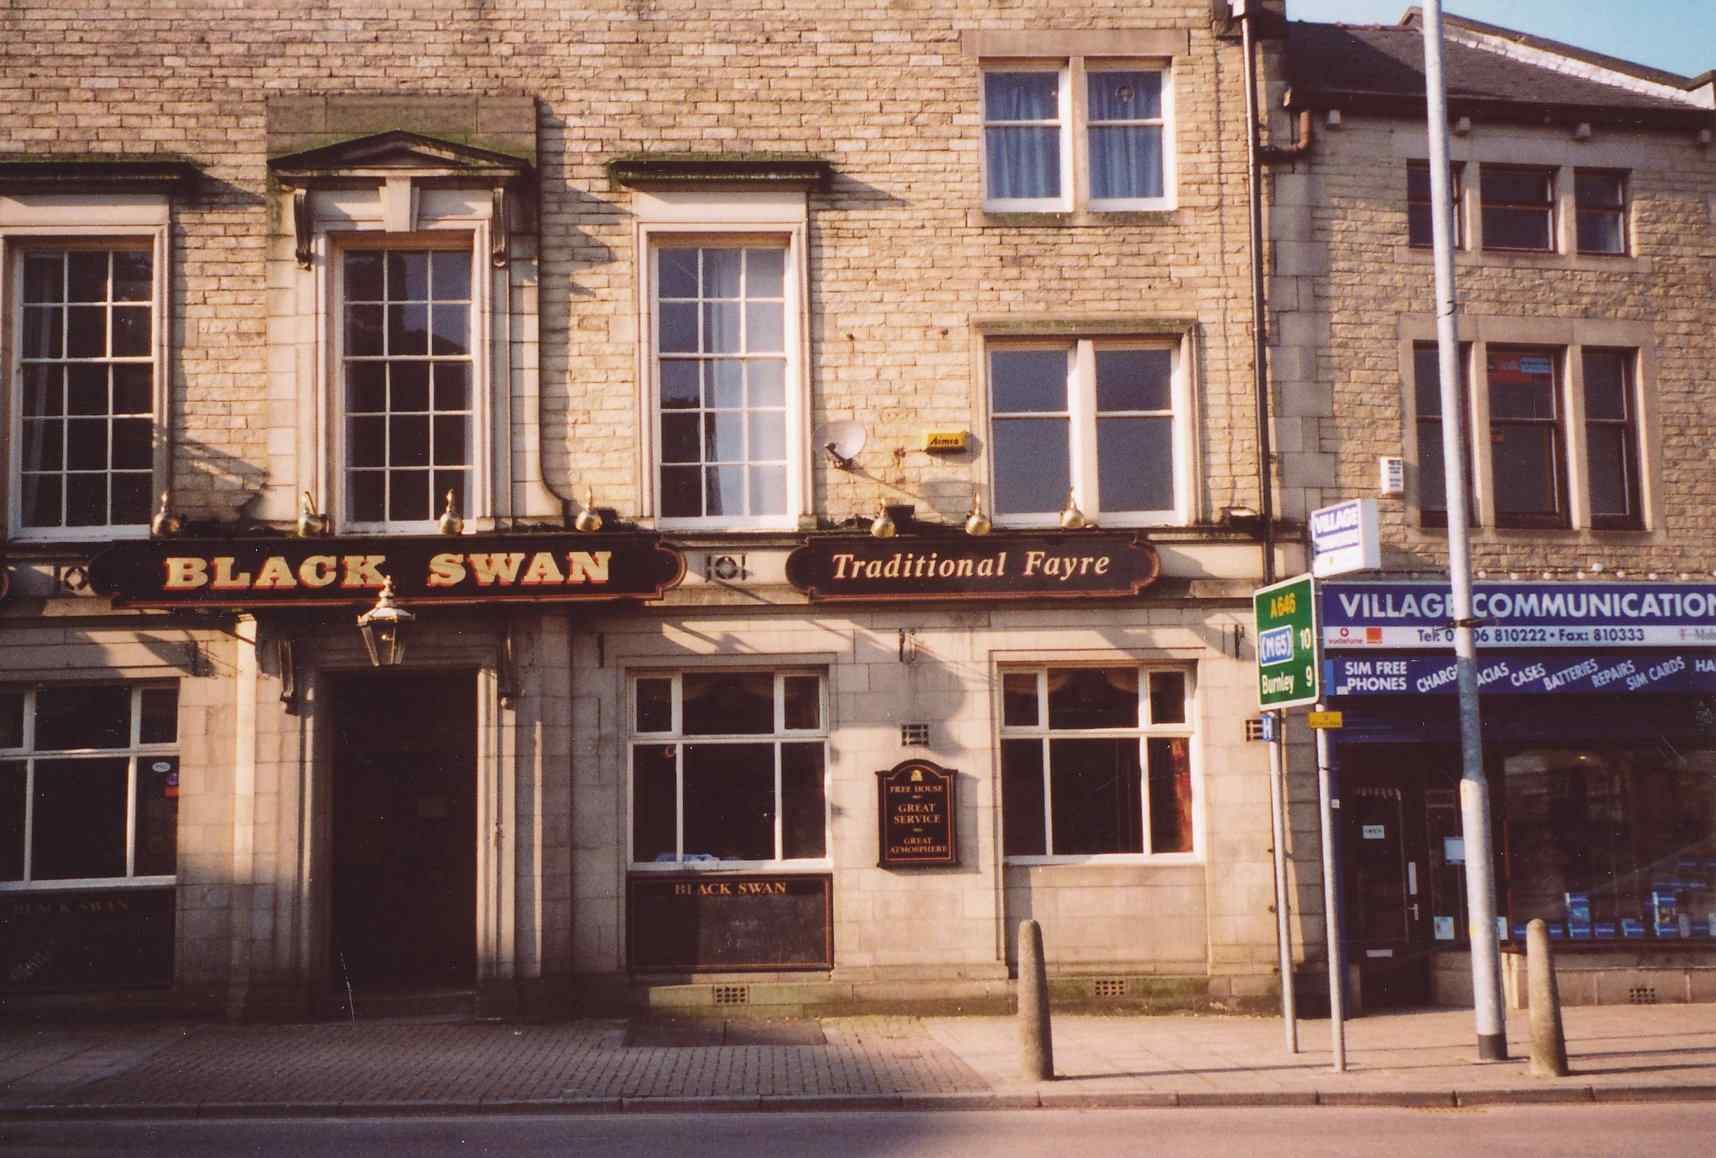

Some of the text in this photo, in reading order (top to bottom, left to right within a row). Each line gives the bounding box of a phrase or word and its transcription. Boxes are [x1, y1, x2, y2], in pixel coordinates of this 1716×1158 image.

[164, 551, 613, 591] BLACK SWAN
[832, 551, 1112, 581] Traditional Fayre
[1300, 628, 1312, 650] 10
[1417, 629, 1439, 642] Tel:
[1495, 629, 1546, 642] 810222
[1559, 629, 1588, 642] Fax:
[1593, 628, 1645, 642] 810333
[1345, 661, 1407, 675] SIM FREE
[1510, 663, 1547, 687] CASES
[1542, 658, 1599, 691] BATTERIES
[1591, 659, 1636, 688] REPAIRS
[1625, 656, 1687, 691] SIM CARDS
[1262, 667, 1313, 695] Burnley 9
[1346, 677, 1407, 691] PHONES
[898, 803, 936, 813] GREAT
[894, 815, 941, 825] SERVICE
[674, 882, 786, 895] BLACK SWAN
